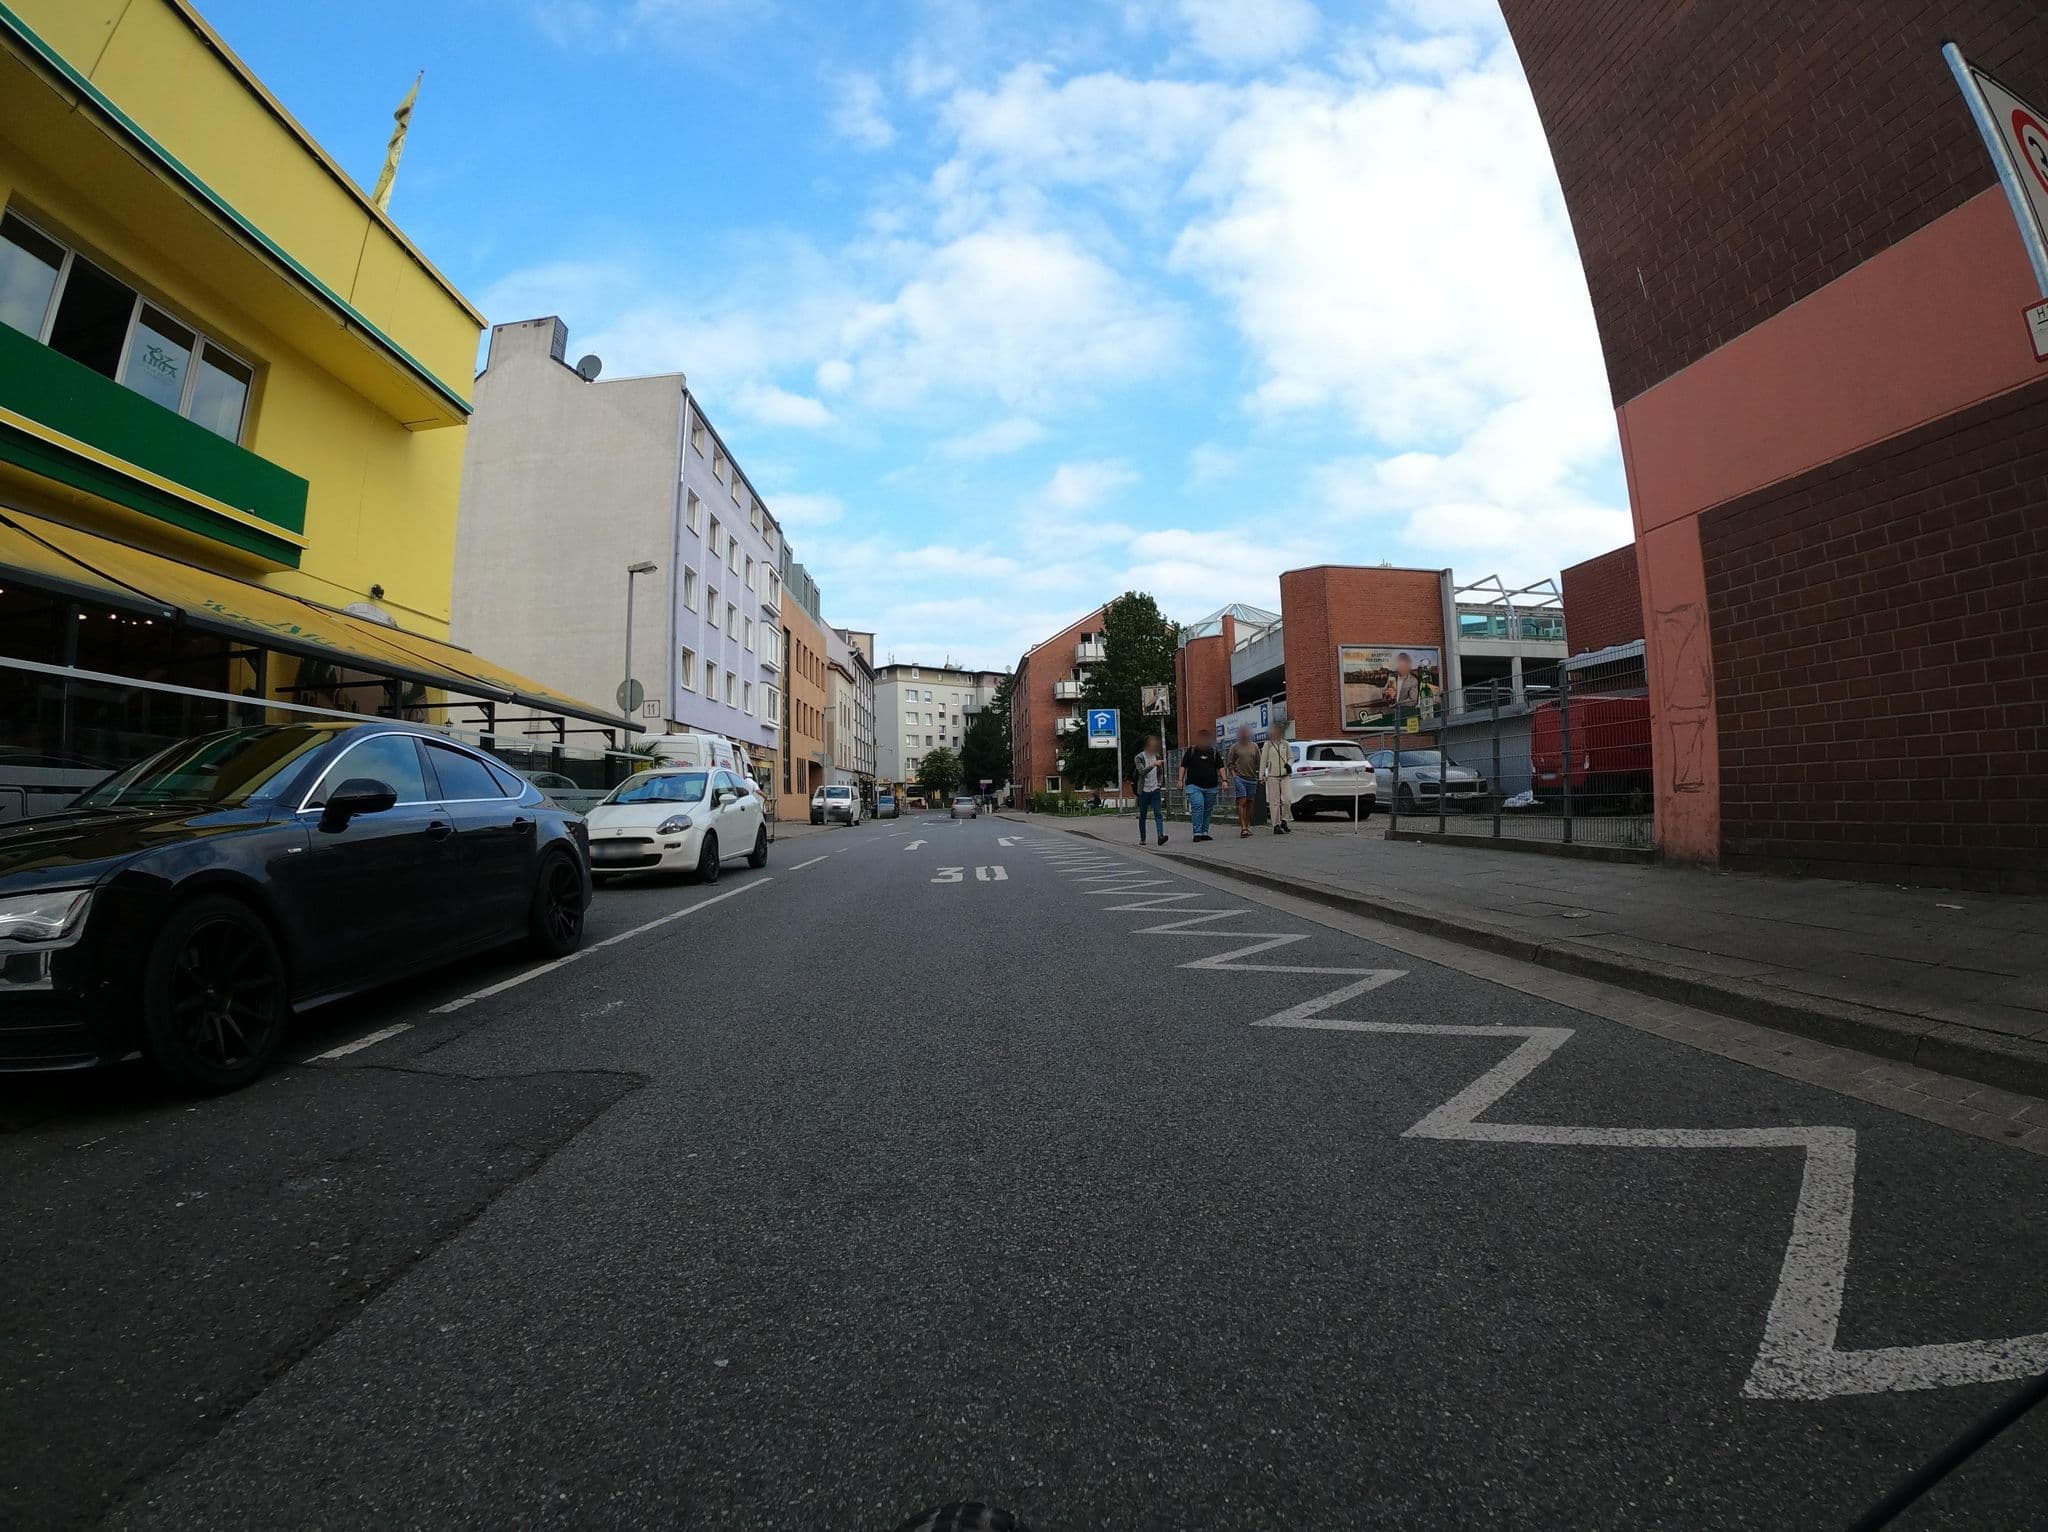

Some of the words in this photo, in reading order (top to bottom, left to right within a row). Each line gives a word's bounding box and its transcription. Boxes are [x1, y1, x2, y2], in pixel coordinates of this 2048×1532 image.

[646, 703, 656, 716] 11
[1097, 717, 1108, 729] P
[930, 865, 1009, 883] 30
